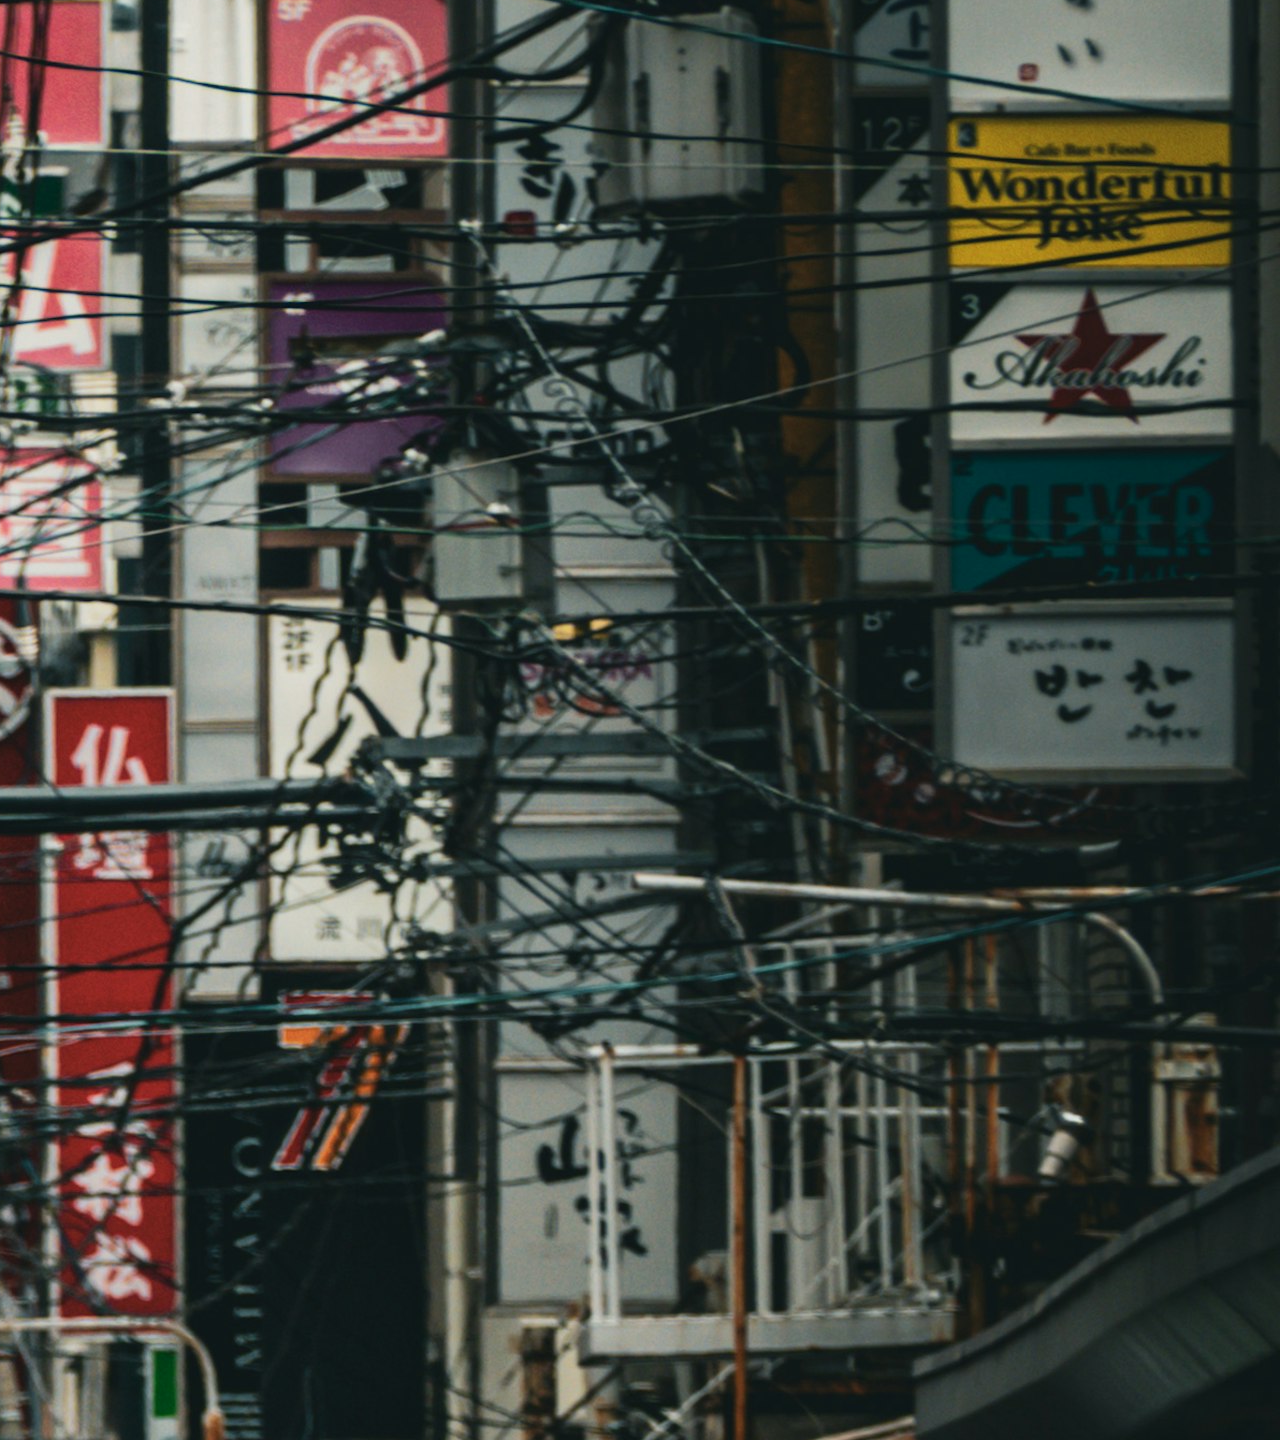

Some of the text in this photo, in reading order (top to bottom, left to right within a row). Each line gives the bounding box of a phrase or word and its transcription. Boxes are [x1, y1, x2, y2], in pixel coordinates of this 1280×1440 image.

[955, 164, 1222, 203] Wonderful
[1032, 206, 1142, 248] Joke
[958, 294, 982, 321] 3
[963, 335, 1207, 389] Akahoshi
[967, 482, 1215, 559] CLEVER
